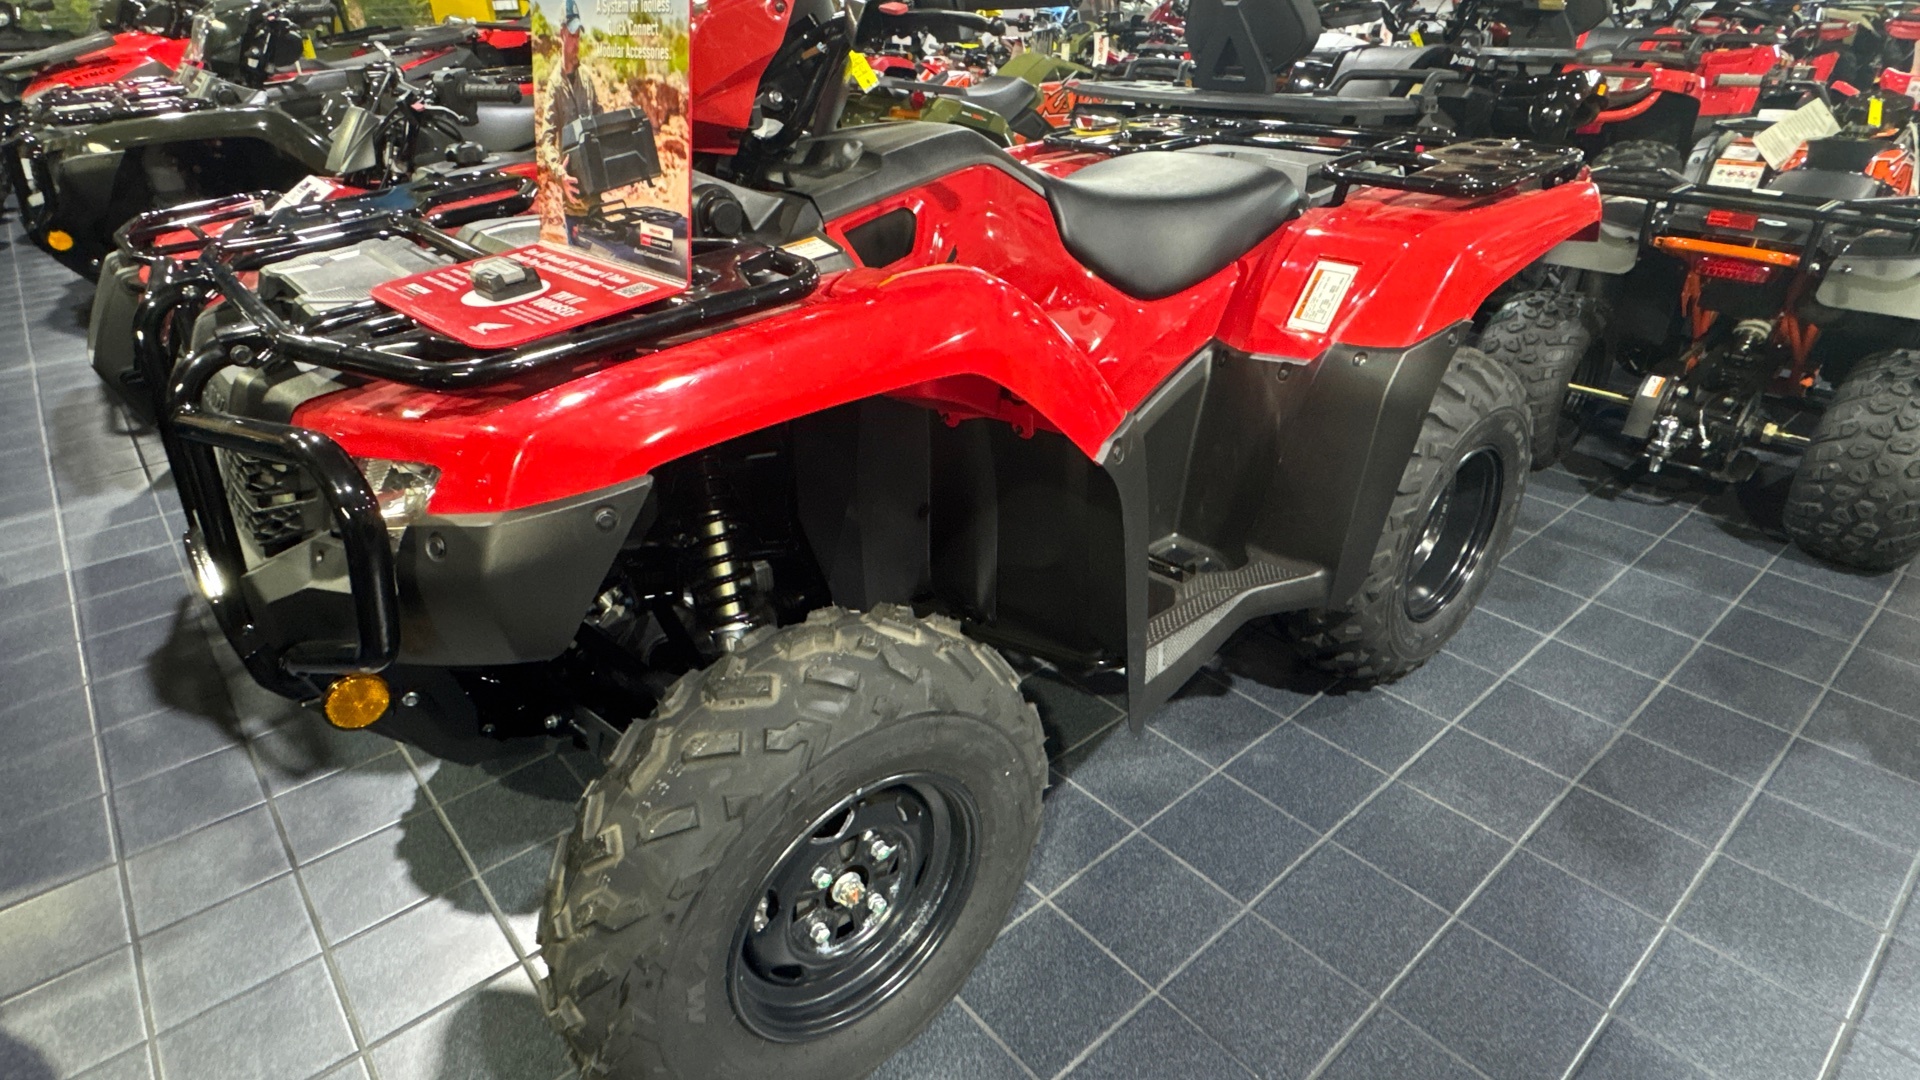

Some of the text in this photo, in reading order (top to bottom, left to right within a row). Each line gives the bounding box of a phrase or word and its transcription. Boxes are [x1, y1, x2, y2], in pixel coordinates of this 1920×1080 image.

[602, 0, 629, 17] System
[630, 0, 638, 13] of
[640, 0, 673, 14] Toolless,
[608, 20, 659, 37] Quick Connect
[597, 42, 671, 60] Modular Accessories.
